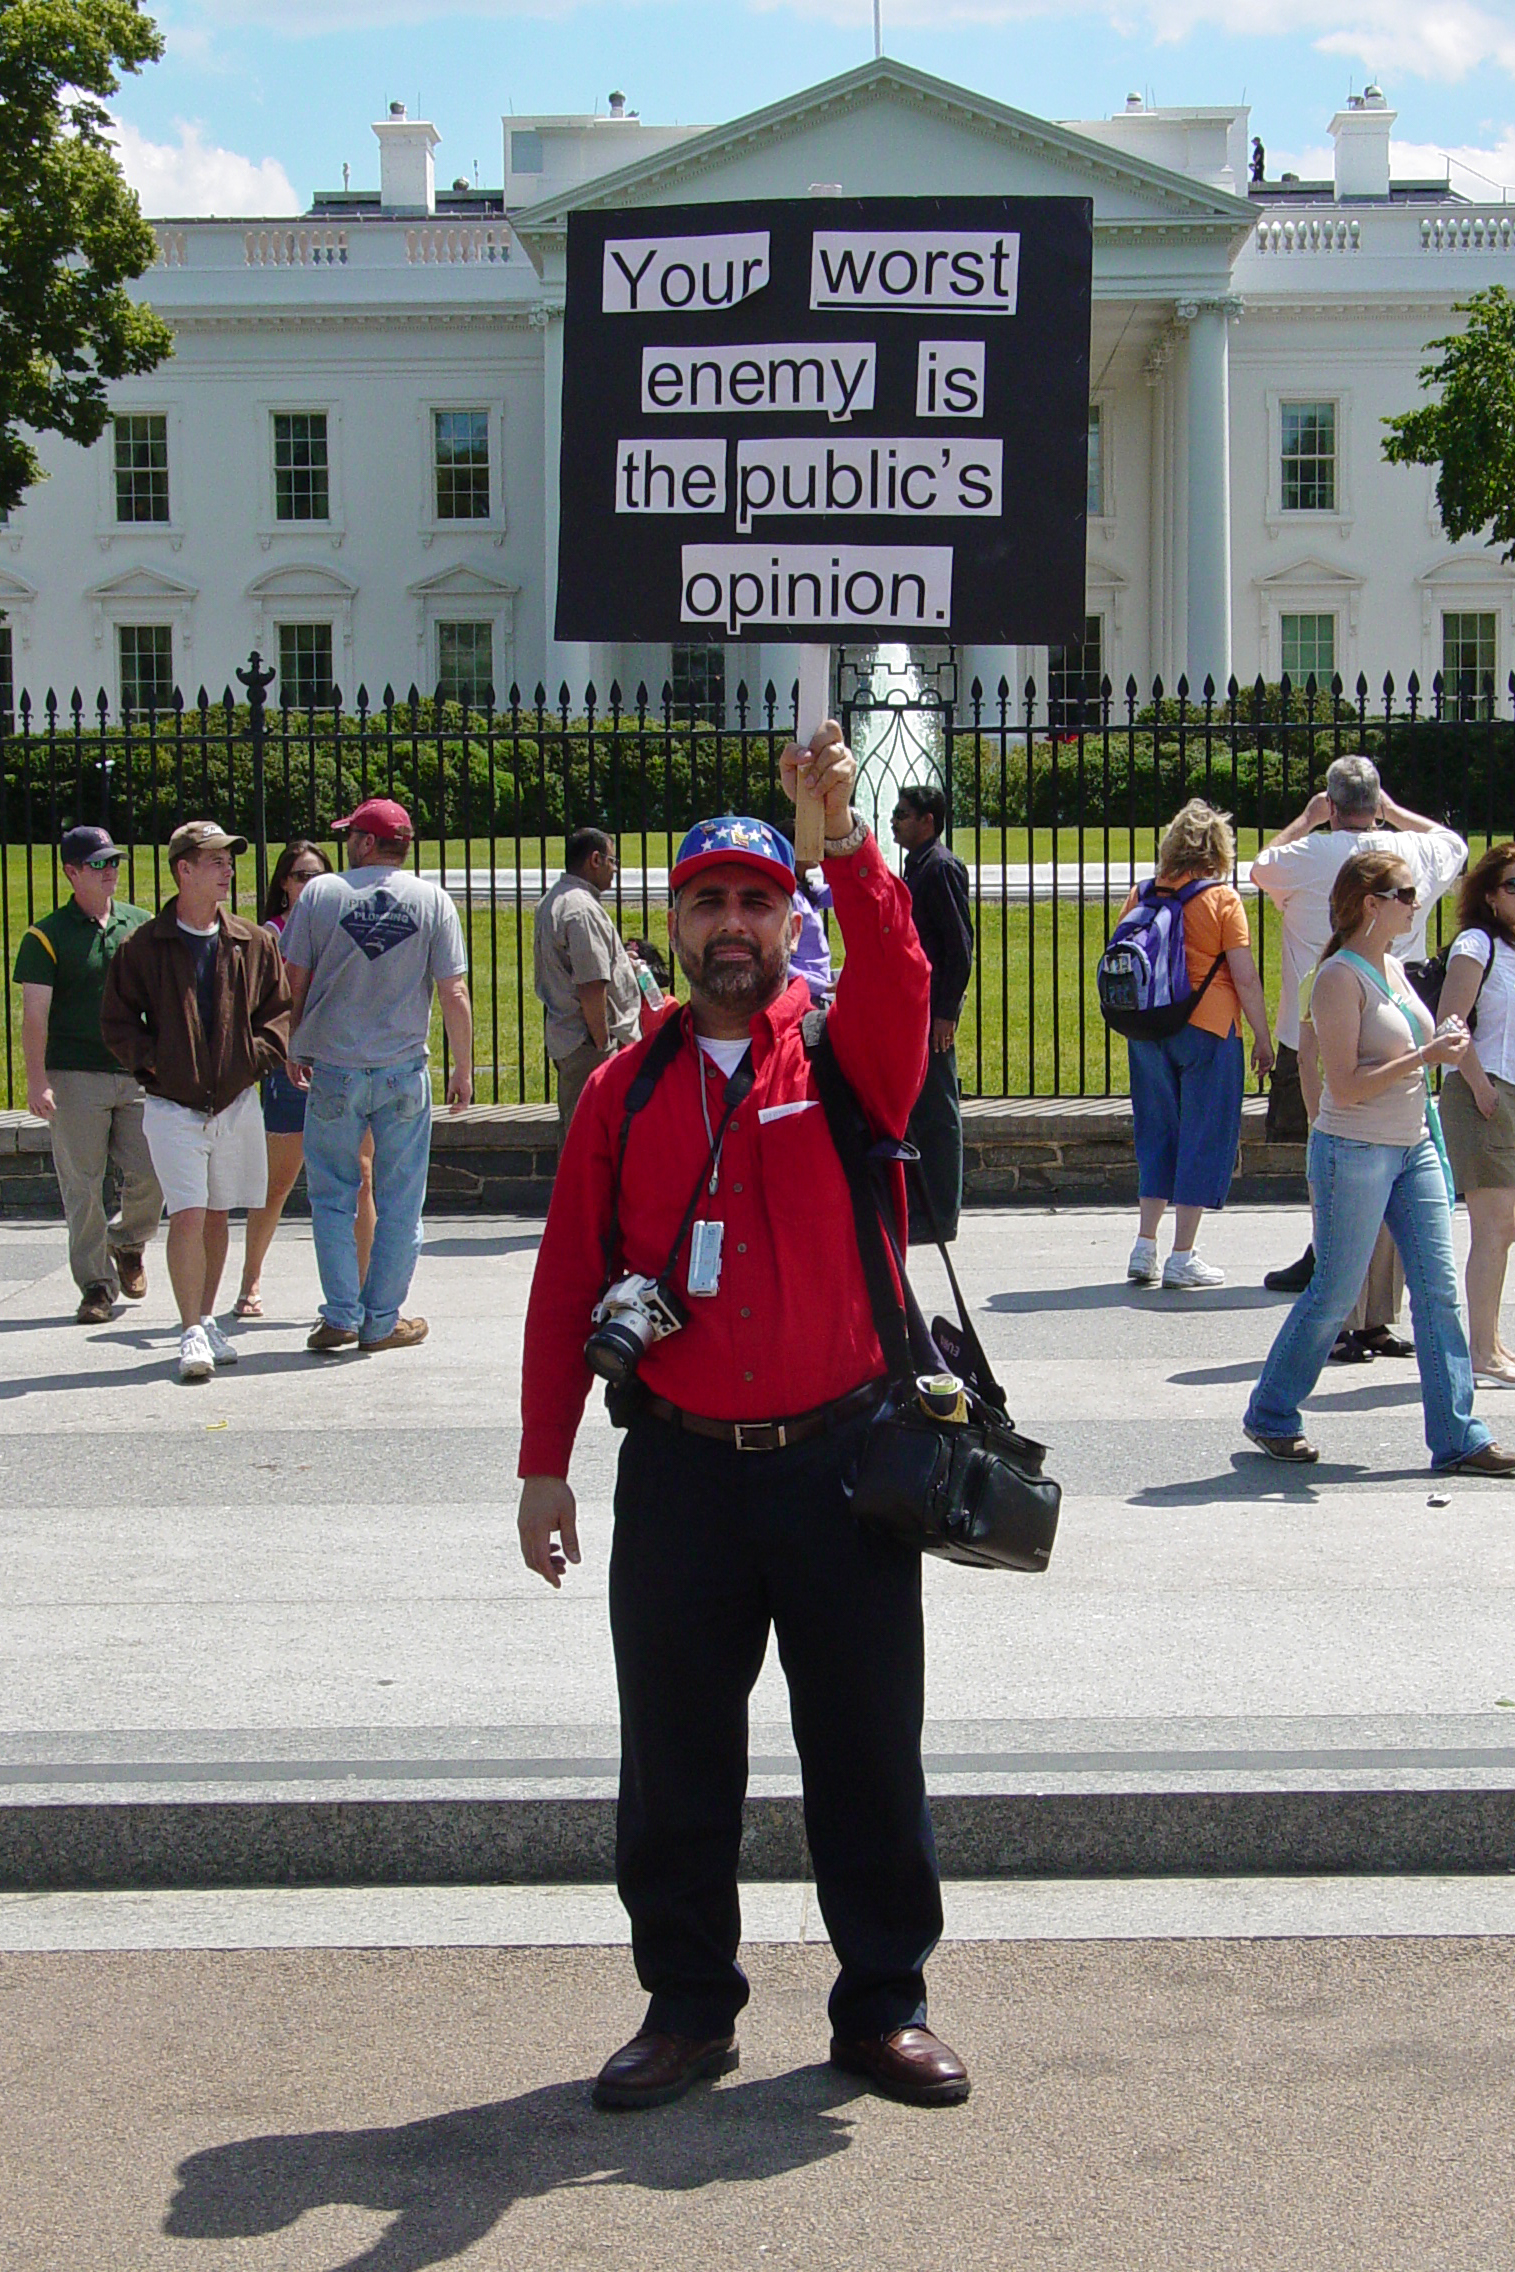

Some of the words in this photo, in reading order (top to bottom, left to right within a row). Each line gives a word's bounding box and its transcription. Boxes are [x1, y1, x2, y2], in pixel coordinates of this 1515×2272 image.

[610, 248, 763, 310] Your
[817, 238, 1010, 298] worst
[646, 356, 869, 420] enemy
[926, 352, 980, 414] is
[622, 450, 718, 509] the
[739, 447, 994, 525] public's
[684, 556, 946, 634] opinion.
